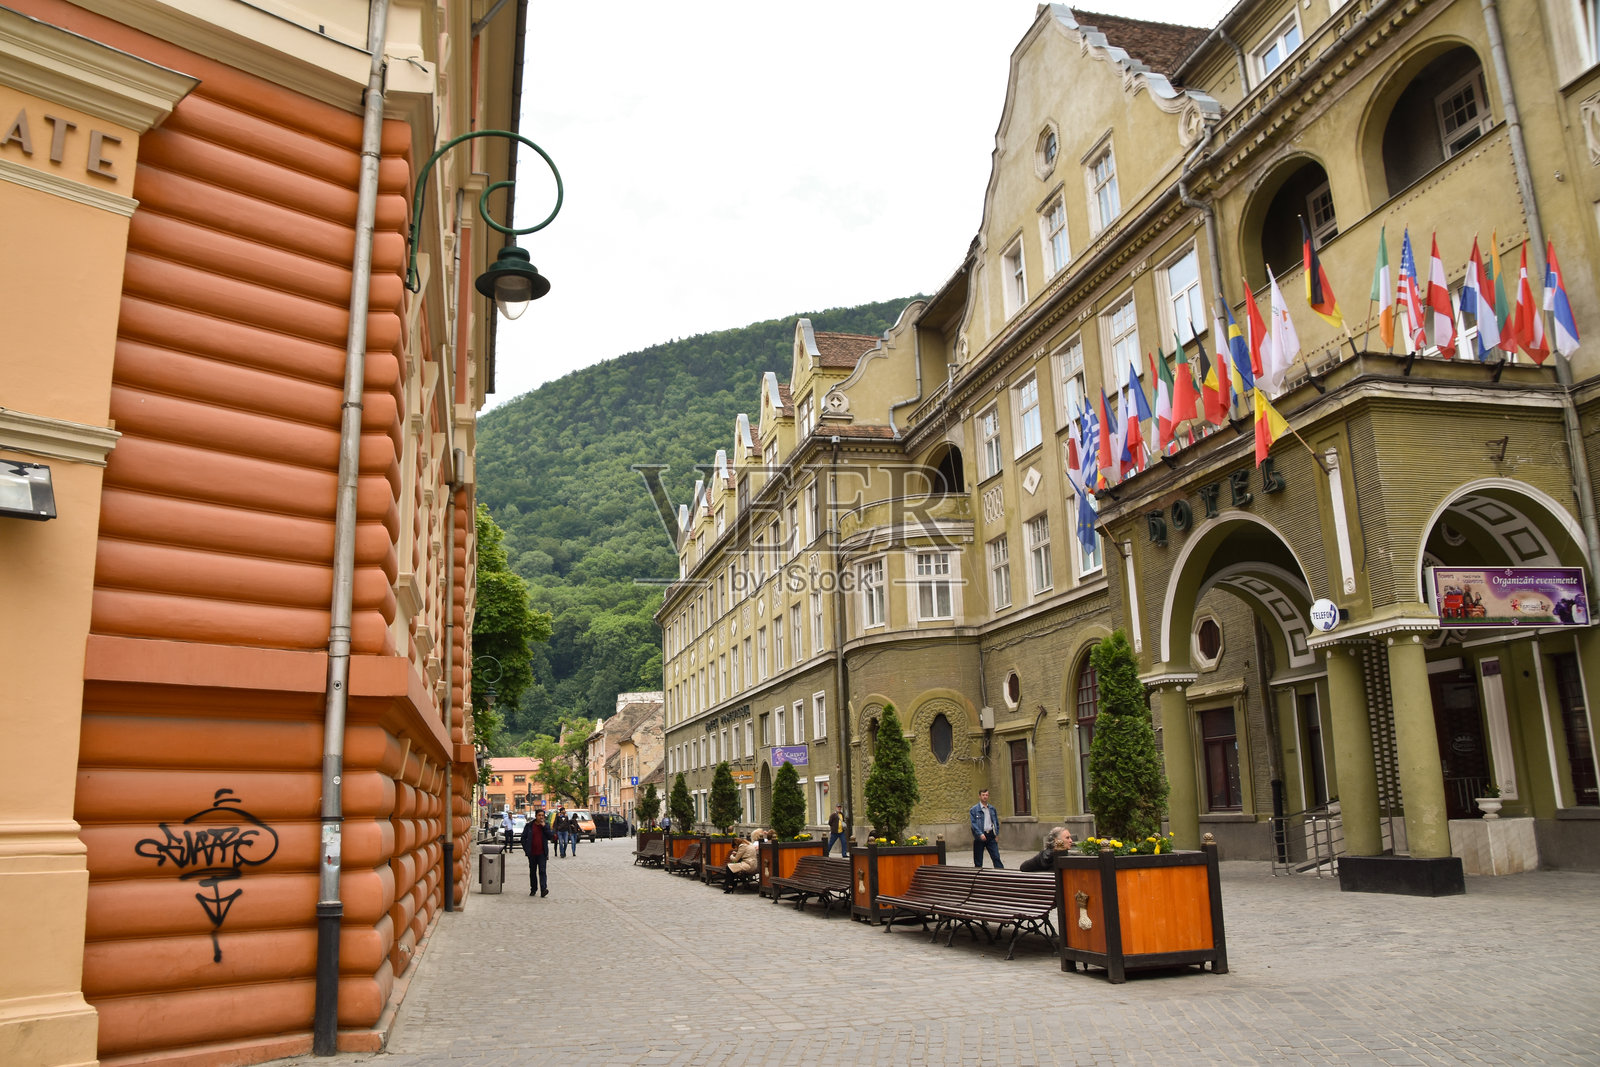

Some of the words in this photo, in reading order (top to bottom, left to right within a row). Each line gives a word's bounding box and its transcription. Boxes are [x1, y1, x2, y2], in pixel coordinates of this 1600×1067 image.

[0, 107, 123, 182] ATE
[1145, 457, 1286, 548] HOTEL
[1492, 574, 1535, 588] Organizări
[1535, 574, 1578, 585] evenimente
[1312, 611, 1333, 620] TELEFON
